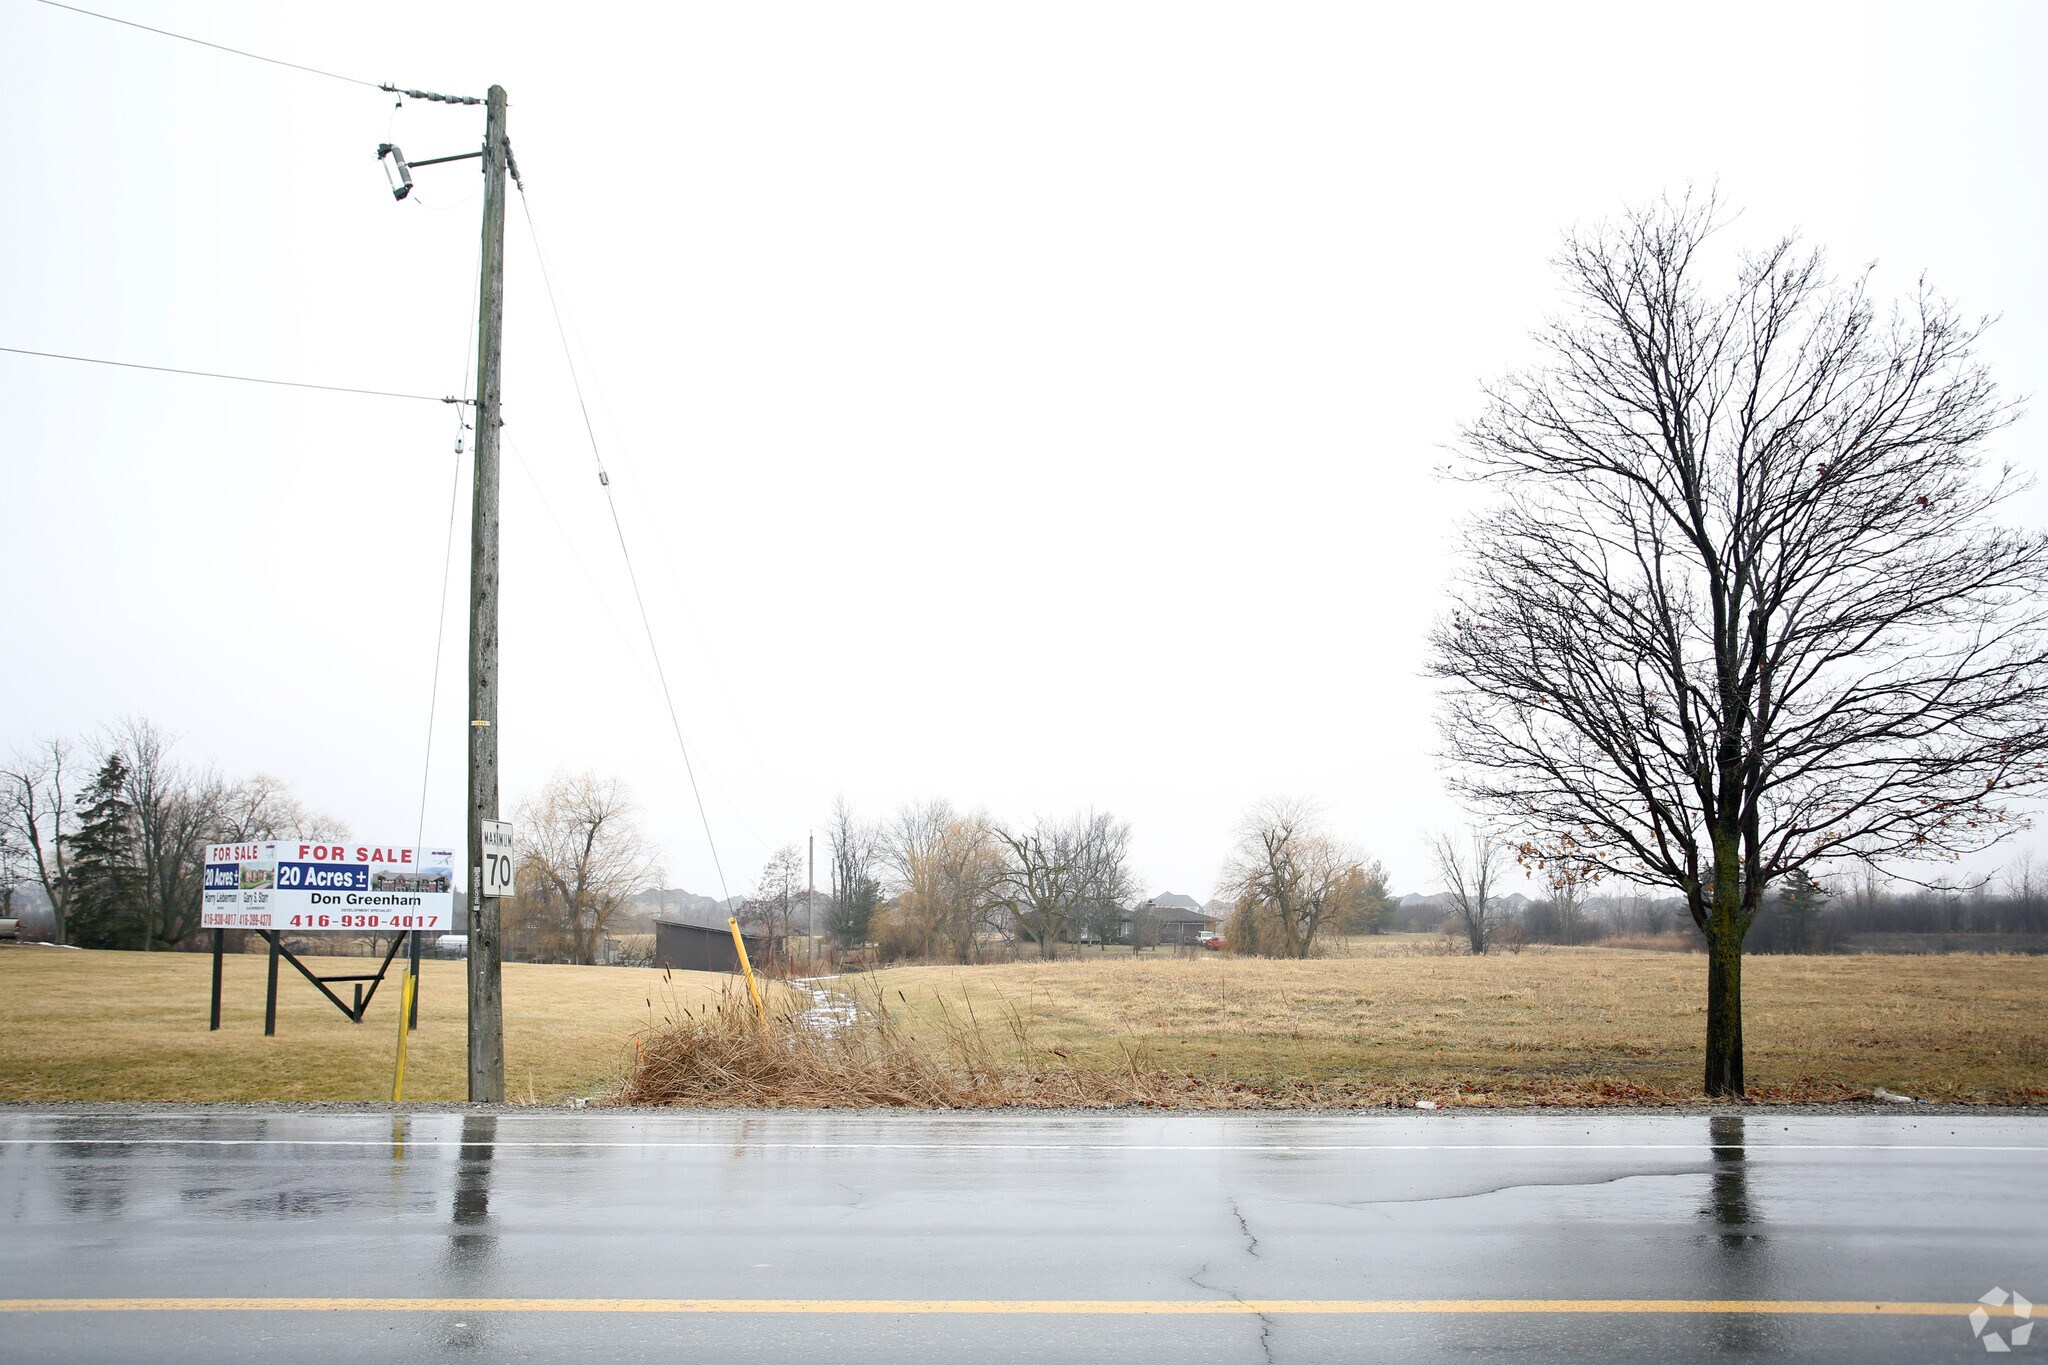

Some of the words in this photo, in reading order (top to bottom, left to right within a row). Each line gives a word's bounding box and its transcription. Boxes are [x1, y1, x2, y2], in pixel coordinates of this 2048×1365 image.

[484, 831, 512, 847] MAXIMUM
[213, 847, 231, 861] FOR
[235, 845, 258, 860] SALE
[299, 845, 345, 861] FOR
[356, 847, 412, 863] SALE
[205, 868, 214, 886] 20
[214, 868, 233, 886] Acres
[280, 866, 301, 886] 20
[304, 866, 353, 887] Acres
[486, 854, 511, 887] 70
[205, 892, 216, 905] Harry
[243, 892, 252, 905] Gary
[311, 893, 341, 904] Don
[346, 894, 421, 905] Greenham
[204, 914, 237, 925] 416-930-4017
[290, 915, 438, 927] 416-930-4017
